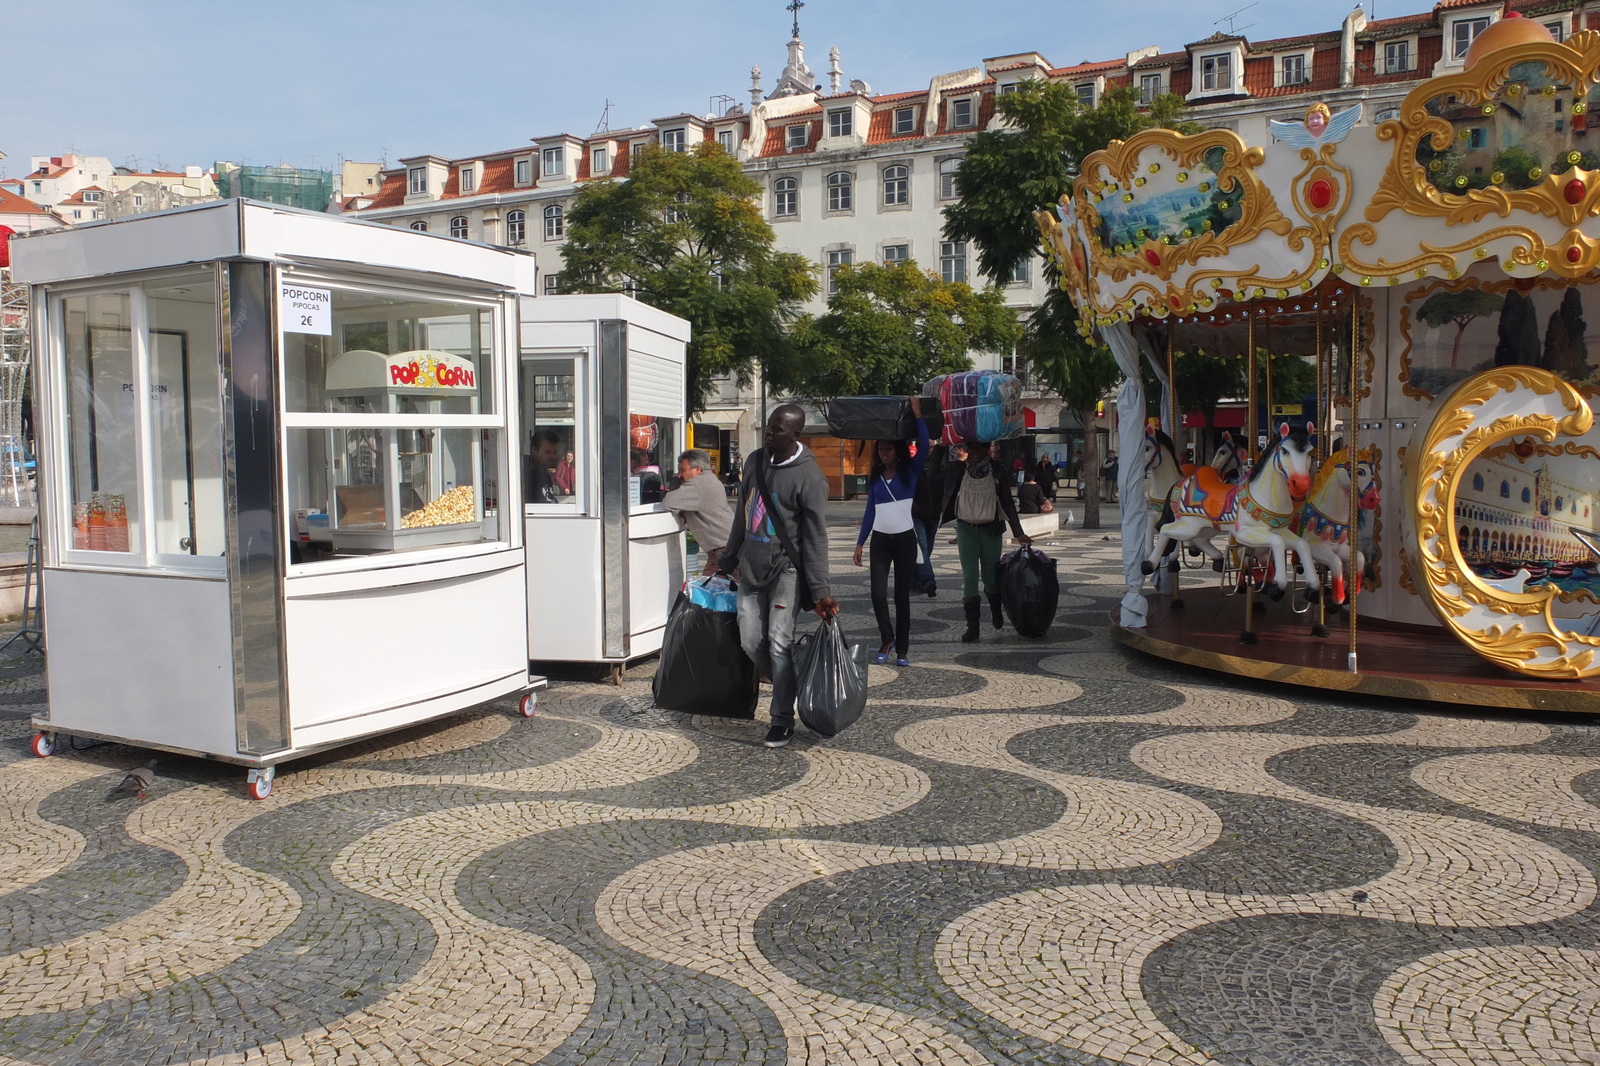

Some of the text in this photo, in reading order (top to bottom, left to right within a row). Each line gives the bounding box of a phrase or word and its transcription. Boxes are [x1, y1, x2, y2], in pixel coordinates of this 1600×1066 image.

[283, 288, 329, 303] POPCORN
[292, 302, 320, 311] PIPOCAS
[301, 315, 313, 326] 2€
[390, 361, 475, 387] POP CORN
